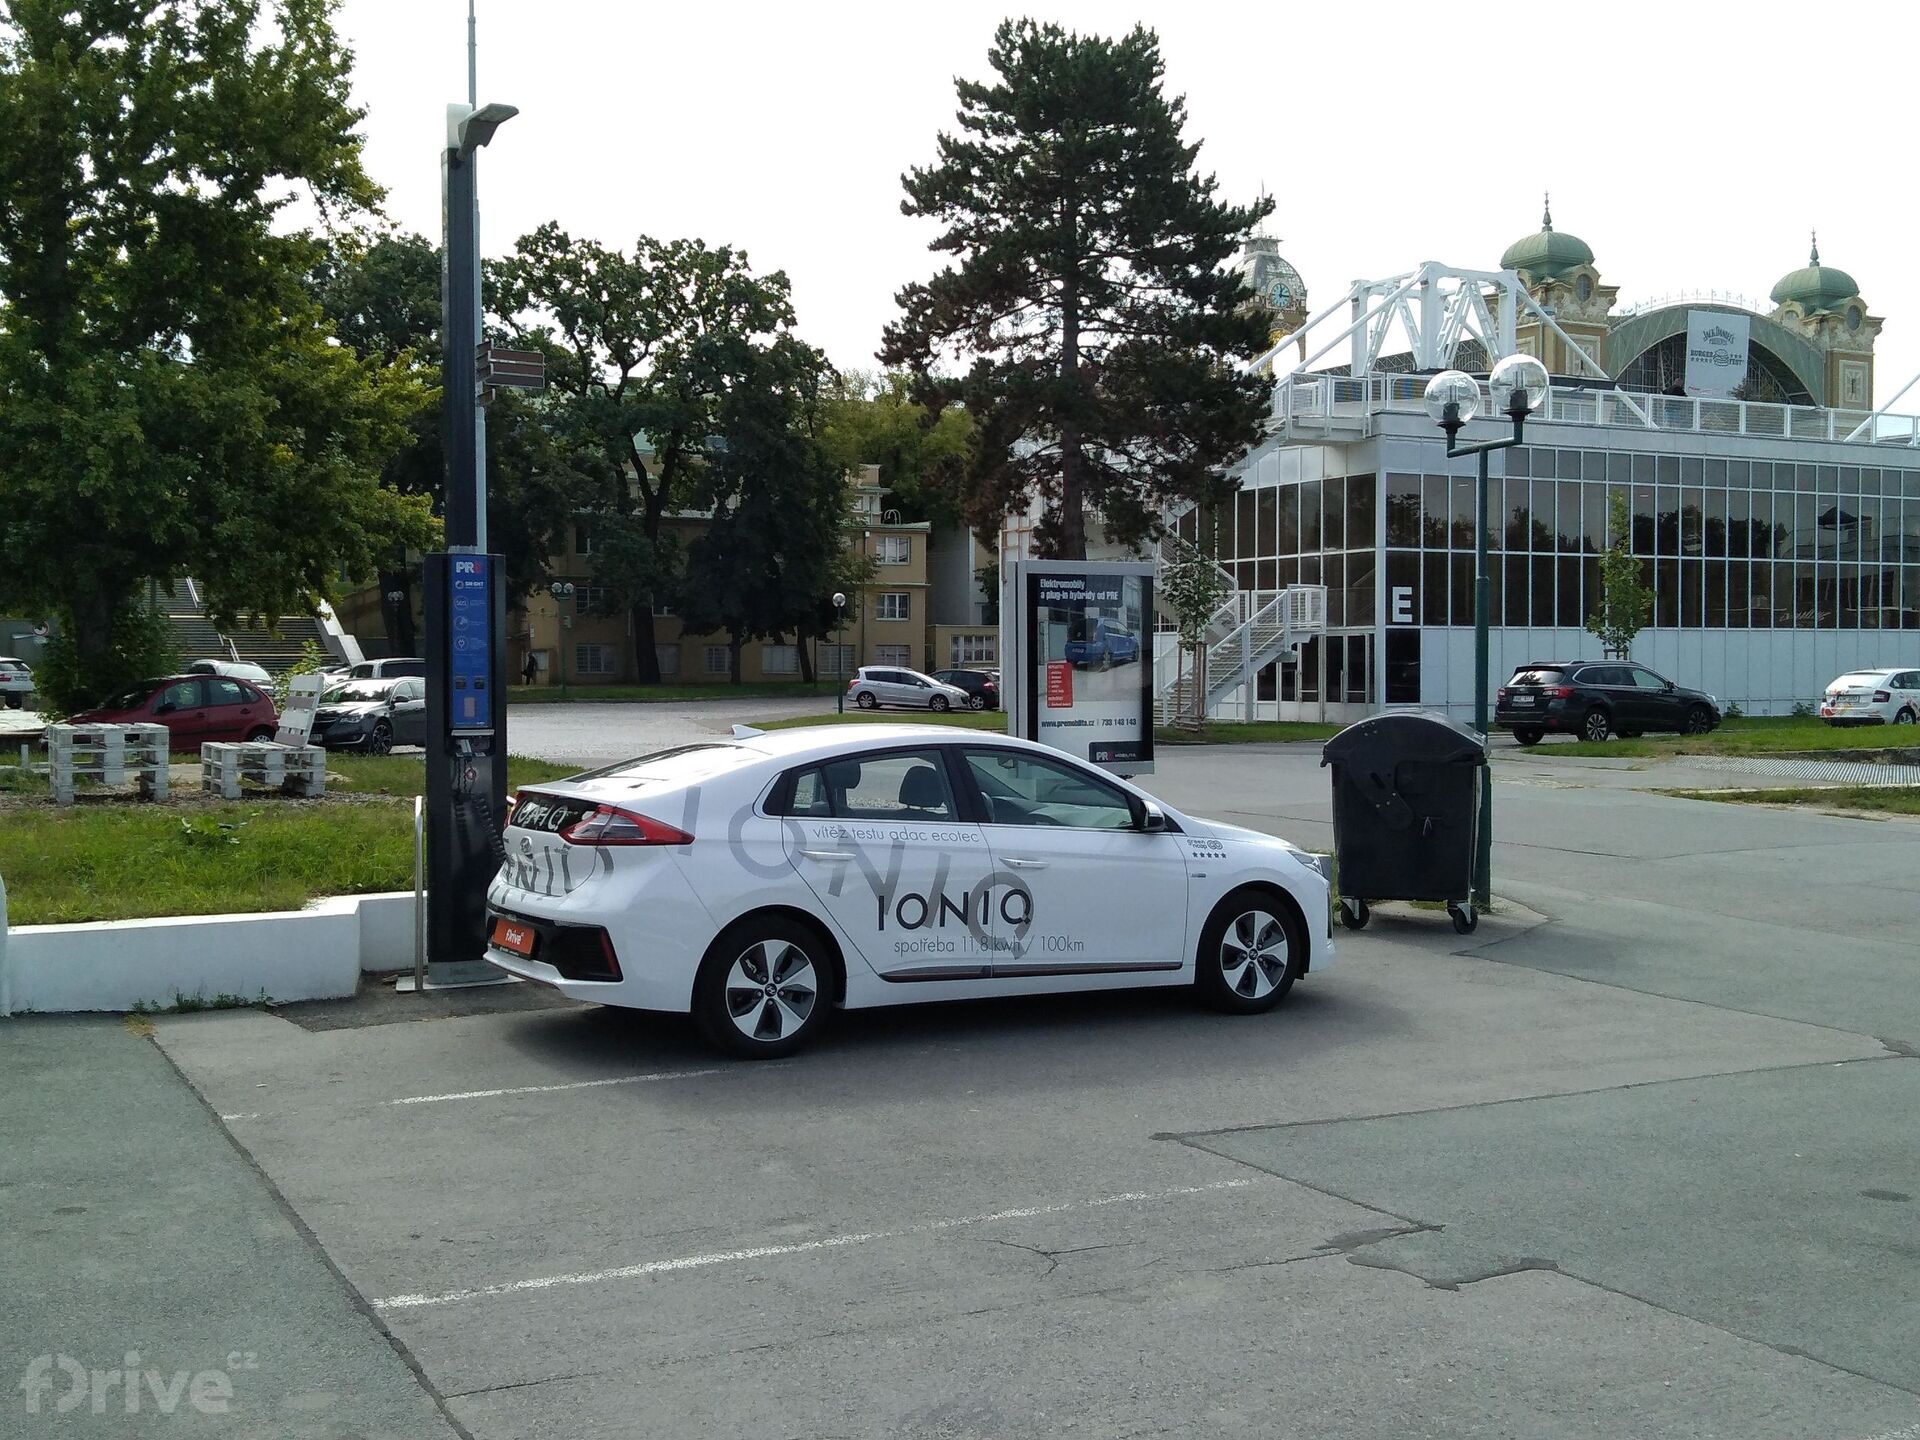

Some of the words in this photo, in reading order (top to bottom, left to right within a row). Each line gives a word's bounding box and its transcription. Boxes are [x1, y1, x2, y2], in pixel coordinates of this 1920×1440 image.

[1040, 578, 1086, 590] Elektromobily
[1040, 591, 1045, 599] a
[1046, 590, 1069, 601] plug-in
[1069, 590, 1096, 601] hybridy
[1097, 591, 1105, 600] od
[1106, 591, 1119, 600] PRE
[1392, 586, 1413, 623] E
[1101, 718, 1113, 727] 733
[1114, 718, 1125, 726] 143
[1126, 718, 1137, 726] 143
[812, 824, 849, 839] vítěz
[851, 825, 885, 840] testu
[889, 826, 928, 842] adac
[931, 830, 980, 843] ecotec
[878, 888, 1032, 931] IONIQ
[894, 935, 955, 957] spotřeba
[961, 935, 990, 955] 11,8
[993, 934, 1021, 952] kwh
[1041, 935, 1085, 952] 100km
